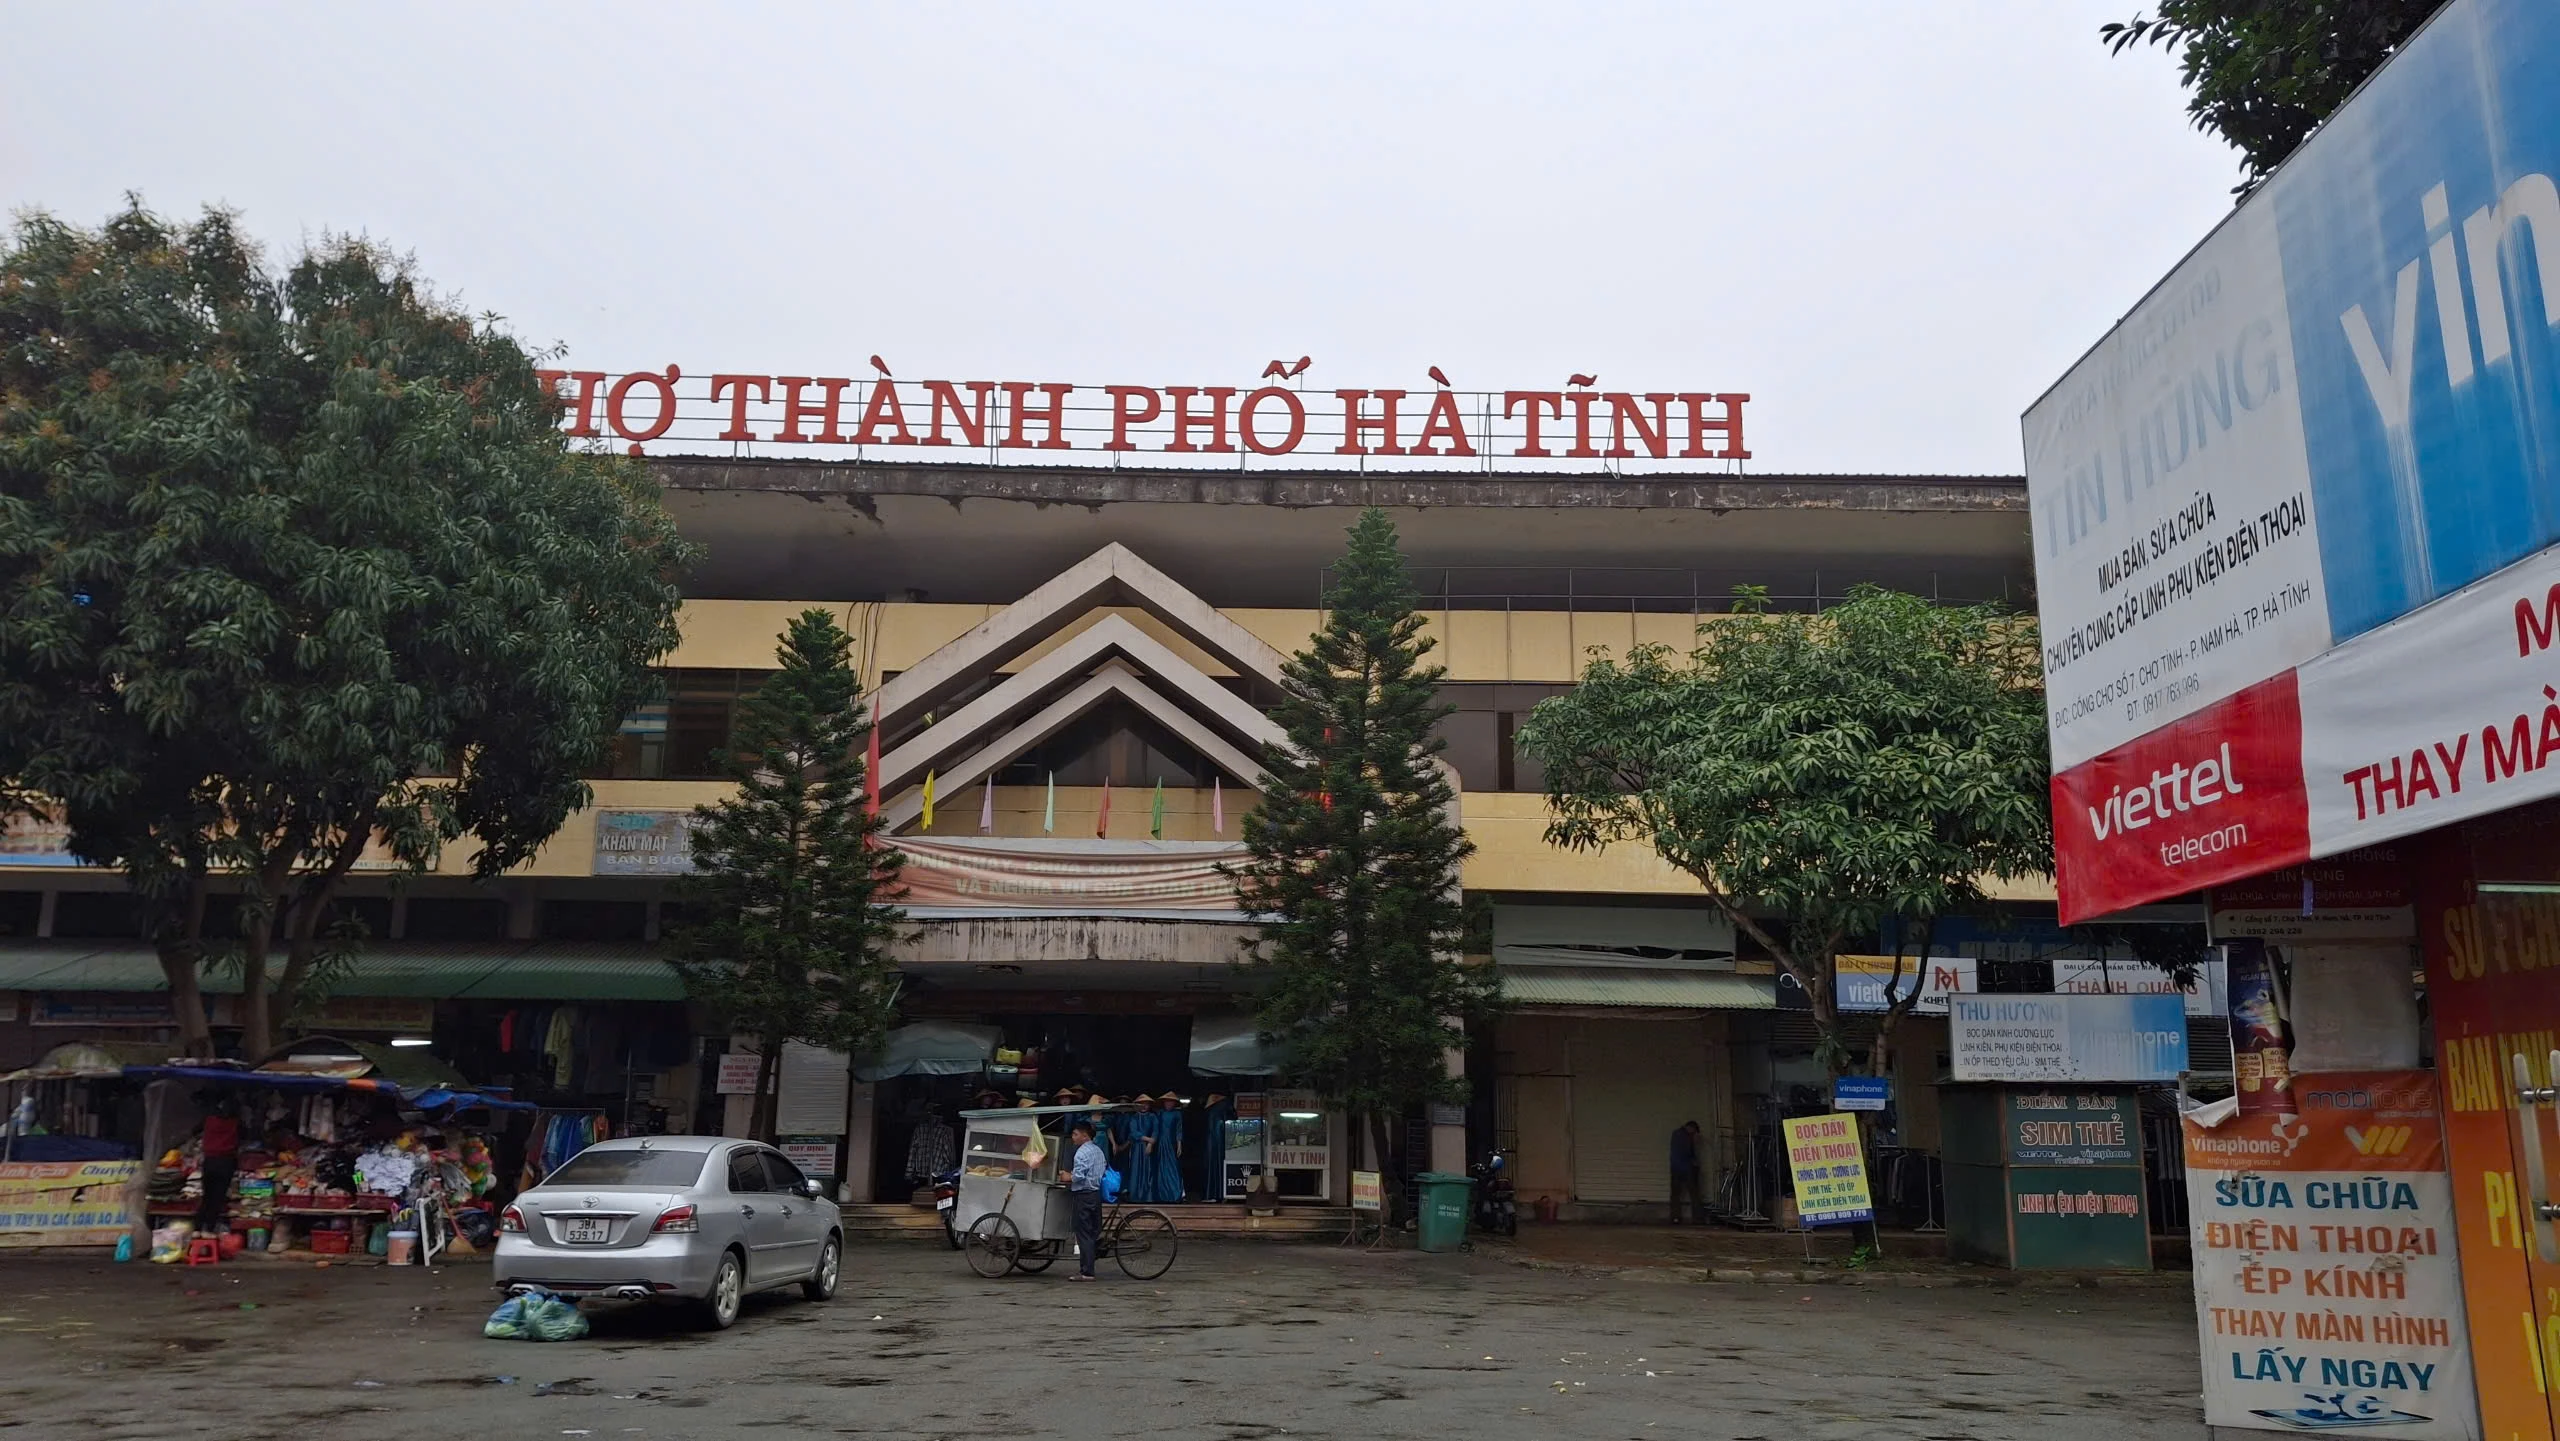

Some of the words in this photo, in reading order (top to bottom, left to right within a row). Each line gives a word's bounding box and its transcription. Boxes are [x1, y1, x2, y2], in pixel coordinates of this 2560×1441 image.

[535, 363, 681, 458] HỢ
[711, 354, 1073, 450] THÀNH
[1103, 354, 1305, 456] PHỐ
[1335, 365, 1477, 457] HÀ
[1503, 373, 1752, 459] TĨNH
[2099, 556, 2122, 595] MUA
[2122, 536, 2150, 579] BÁN,
[2150, 517, 2178, 560] SỬA
[2178, 490, 2217, 541] CHỮA
[2046, 627, 2086, 680] CHUYÊN
[2086, 610, 2116, 658] CUNG
[2116, 588, 2139, 634] CẤP
[2139, 579, 2168, 620] LINH
[2168, 563, 2194, 601] PHỤ
[2194, 540, 2226, 588] KIỆN
[2226, 519, 2260, 572] ĐIỆN
[2259, 491, 2307, 548] THOẠI
[2095, 682, 2115, 708] CHỢ
[2115, 673, 2130, 698] SỐ
[2139, 657, 2160, 687] CHỢ
[2200, 628, 2224, 655] NAM
[2244, 608, 2262, 627] TP.
[2262, 595, 2280, 622] HÀ
[2280, 578, 2312, 616] TĨNH
[2088, 741, 2244, 842] viettel
[2343, 732, 2470, 821] THAY
[2160, 820, 2247, 868] telecom
[1956, 1001, 1991, 1021] THU
[2445, 1022, 2499, 1112] BÁN
[1839, 1084, 1883, 1093] vinaphone
[1795, 1124, 1819, 1142] BỌC
[2020, 1120, 2073, 1146] SIM
[2075, 1112, 2126, 1146] THẺ
[2191, 1135, 2281, 1156] vinaphone
[1271, 1149, 1297, 1165] MÁY
[1299, 1150, 1326, 1165] TÍNH
[1822, 1142, 1858, 1161] THOẠI
[2018, 1193, 2045, 1213] LINH
[2104, 1193, 2139, 1217] THOẠI
[2305, 1176, 2420, 1211] CHỮA
[569, 1230, 604, 1241] 539.17
[2205, 1218, 2299, 1257] ĐIỆN
[2309, 1225, 2438, 1260] THOẠI
[2303, 1264, 2406, 1300] KÍNH
[2209, 1306, 2287, 1339] THAY
[2295, 1308, 2365, 1343] MÀN
[2372, 1311, 2451, 1348] HÌNH
[2231, 1346, 2308, 1384] LẤY
[2320, 1358, 2437, 1392] NGAY
